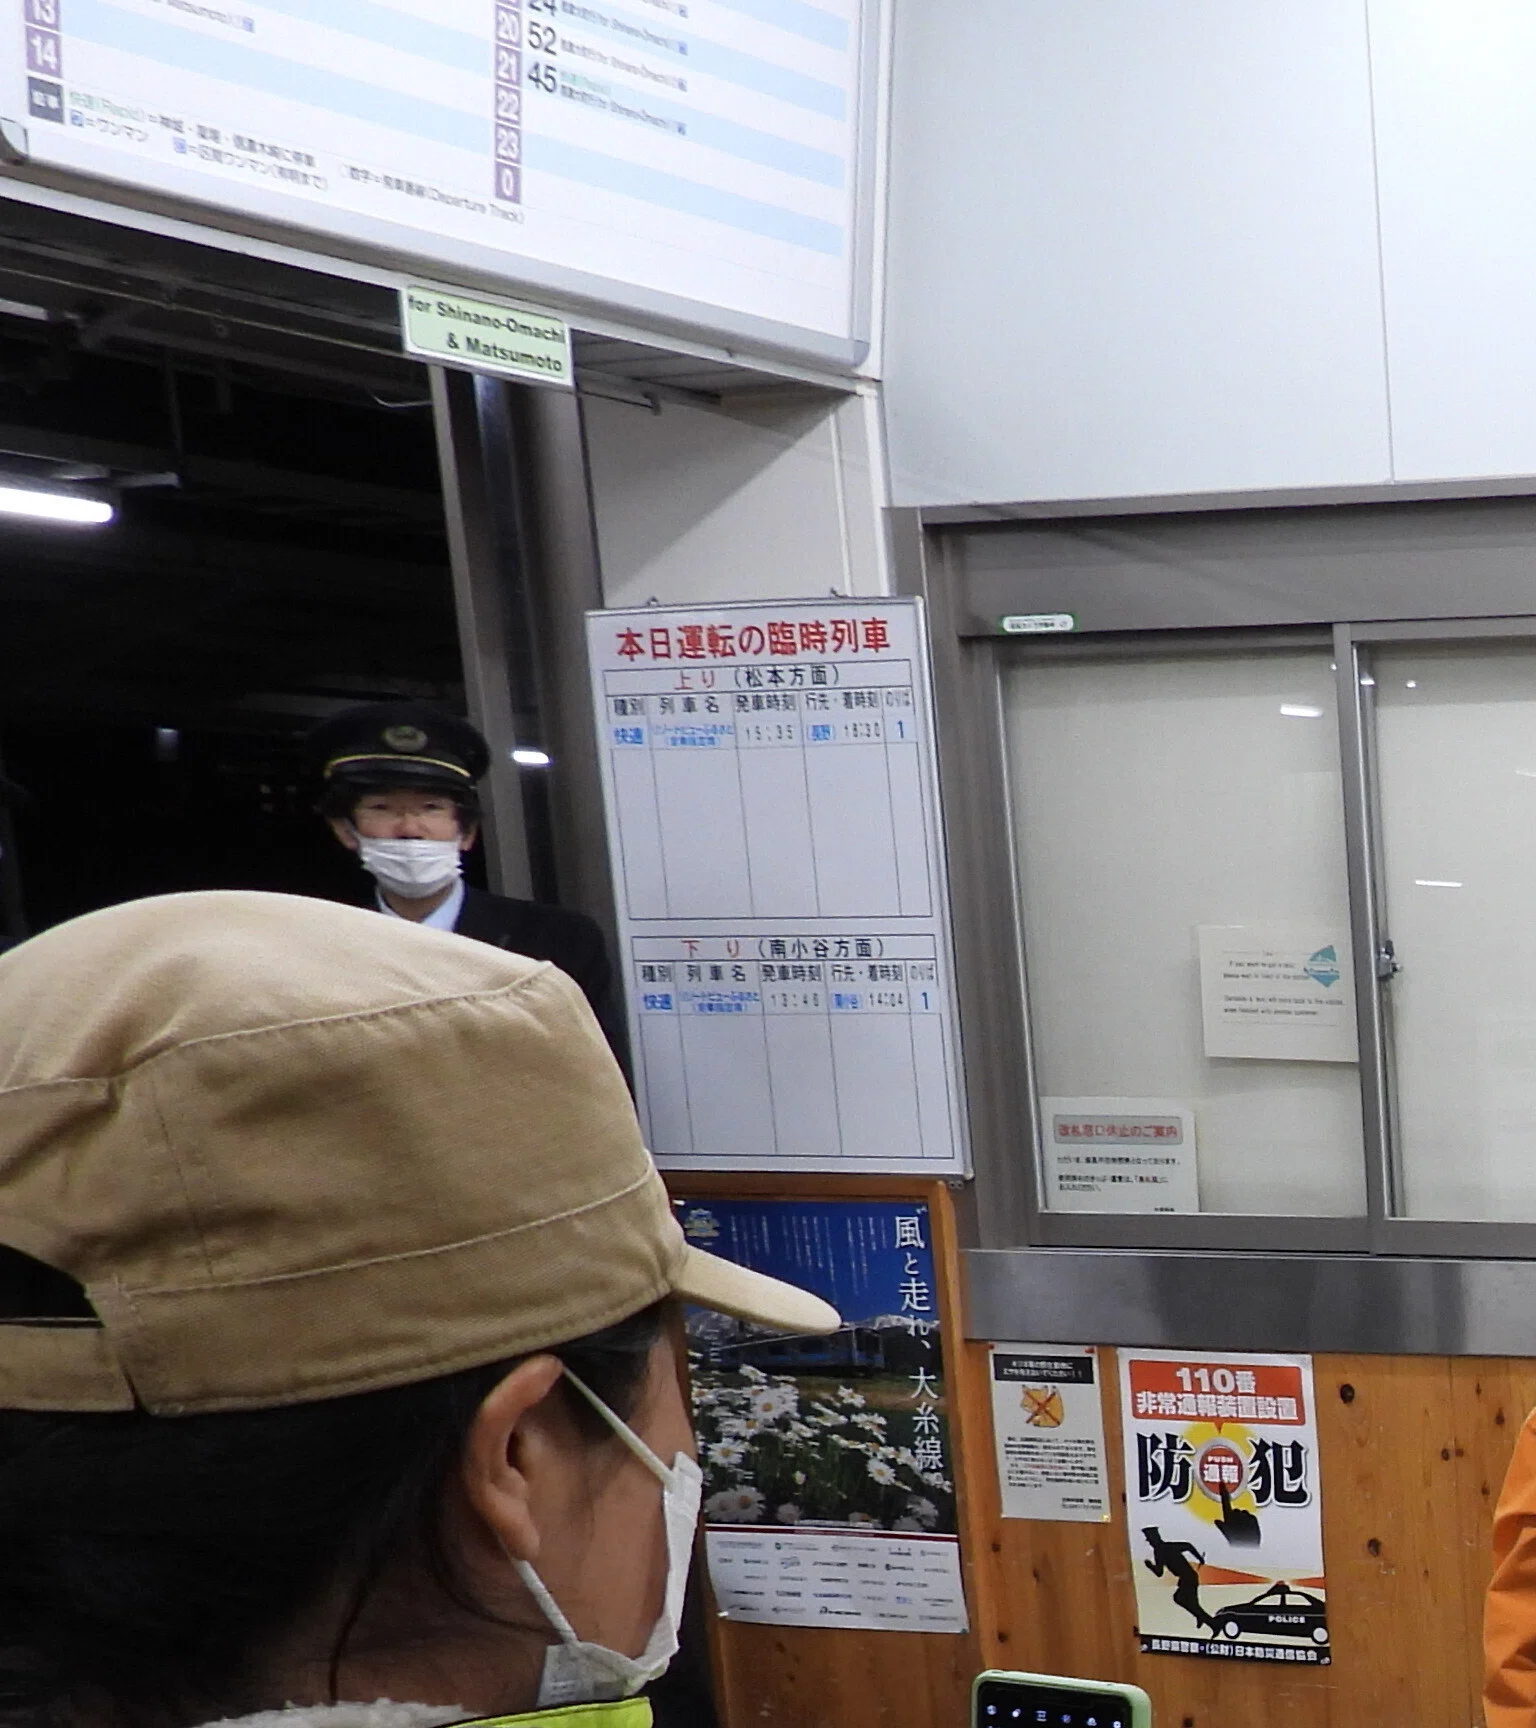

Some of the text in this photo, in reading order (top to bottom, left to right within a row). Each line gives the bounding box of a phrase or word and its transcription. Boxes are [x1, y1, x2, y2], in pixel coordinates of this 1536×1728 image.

[30, 34, 58, 70] 14
[527, 21, 558, 56] 52
[527, 62, 558, 94] 45
[500, 168, 515, 198] 0
[408, 295, 565, 344] for Shinano-Omachi
[447, 332, 563, 372] & Matsumoto
[616, 617, 891, 661] 本日運転の臨時列車
[674, 669, 715, 690] 上り
[613, 698, 646, 716] 種別
[659, 695, 721, 714] 列車名
[736, 694, 798, 712] 発車時刻
[896, 720, 904, 740] 1
[641, 965, 673, 982] 種別
[686, 964, 747, 982] 列車名
[762, 964, 822, 981] 発車時刻
[921, 991, 929, 1010] 1
[1176, 1367, 1256, 1394] 110番
[1136, 1391, 1299, 1420] 非常通報装置設置
[1207, 1455, 1234, 1464] PUSH
[1203, 1463, 1239, 1484] 通報
[1268, 1615, 1307, 1625] POLICE
